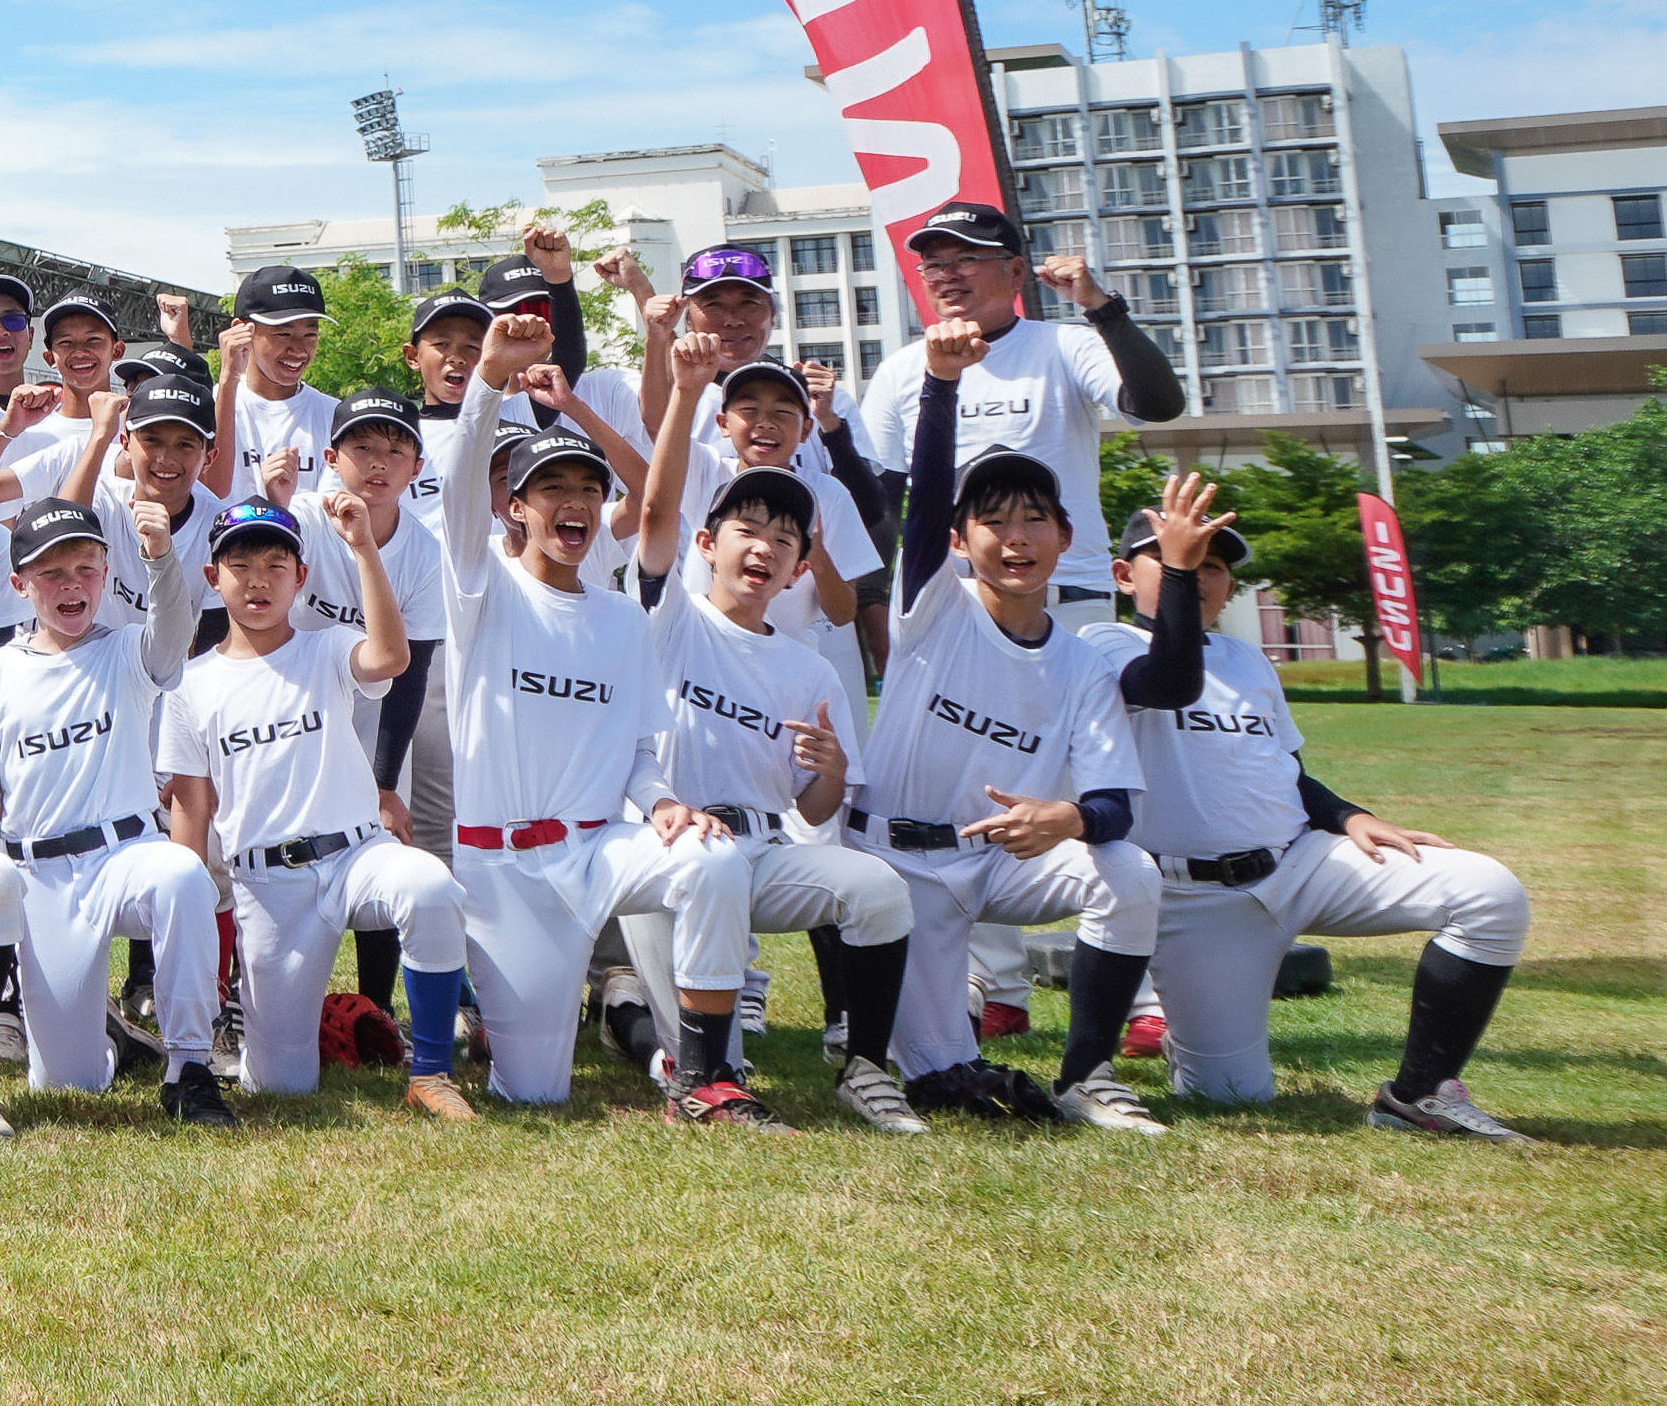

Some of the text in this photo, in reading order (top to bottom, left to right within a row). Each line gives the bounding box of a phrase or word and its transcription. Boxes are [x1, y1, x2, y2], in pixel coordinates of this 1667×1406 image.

[504, 267, 543, 282] ISUZ
[272, 283, 316, 295] ISUZU
[148, 389, 201, 407] ISUZU
[351, 398, 404, 414] ISUZU
[959, 398, 1031, 419] UZU
[531, 437, 591, 455] ISUZU
[31, 508, 85, 531] ISUZU
[1367, 521, 1413, 652] ISUZU
[511, 670, 614, 705] ISUZU
[680, 680, 784, 741] ISUZU
[18, 712, 113, 760] ISUZU
[220, 711, 324, 758] ISUZU
[928, 693, 1042, 756] ISUZU
